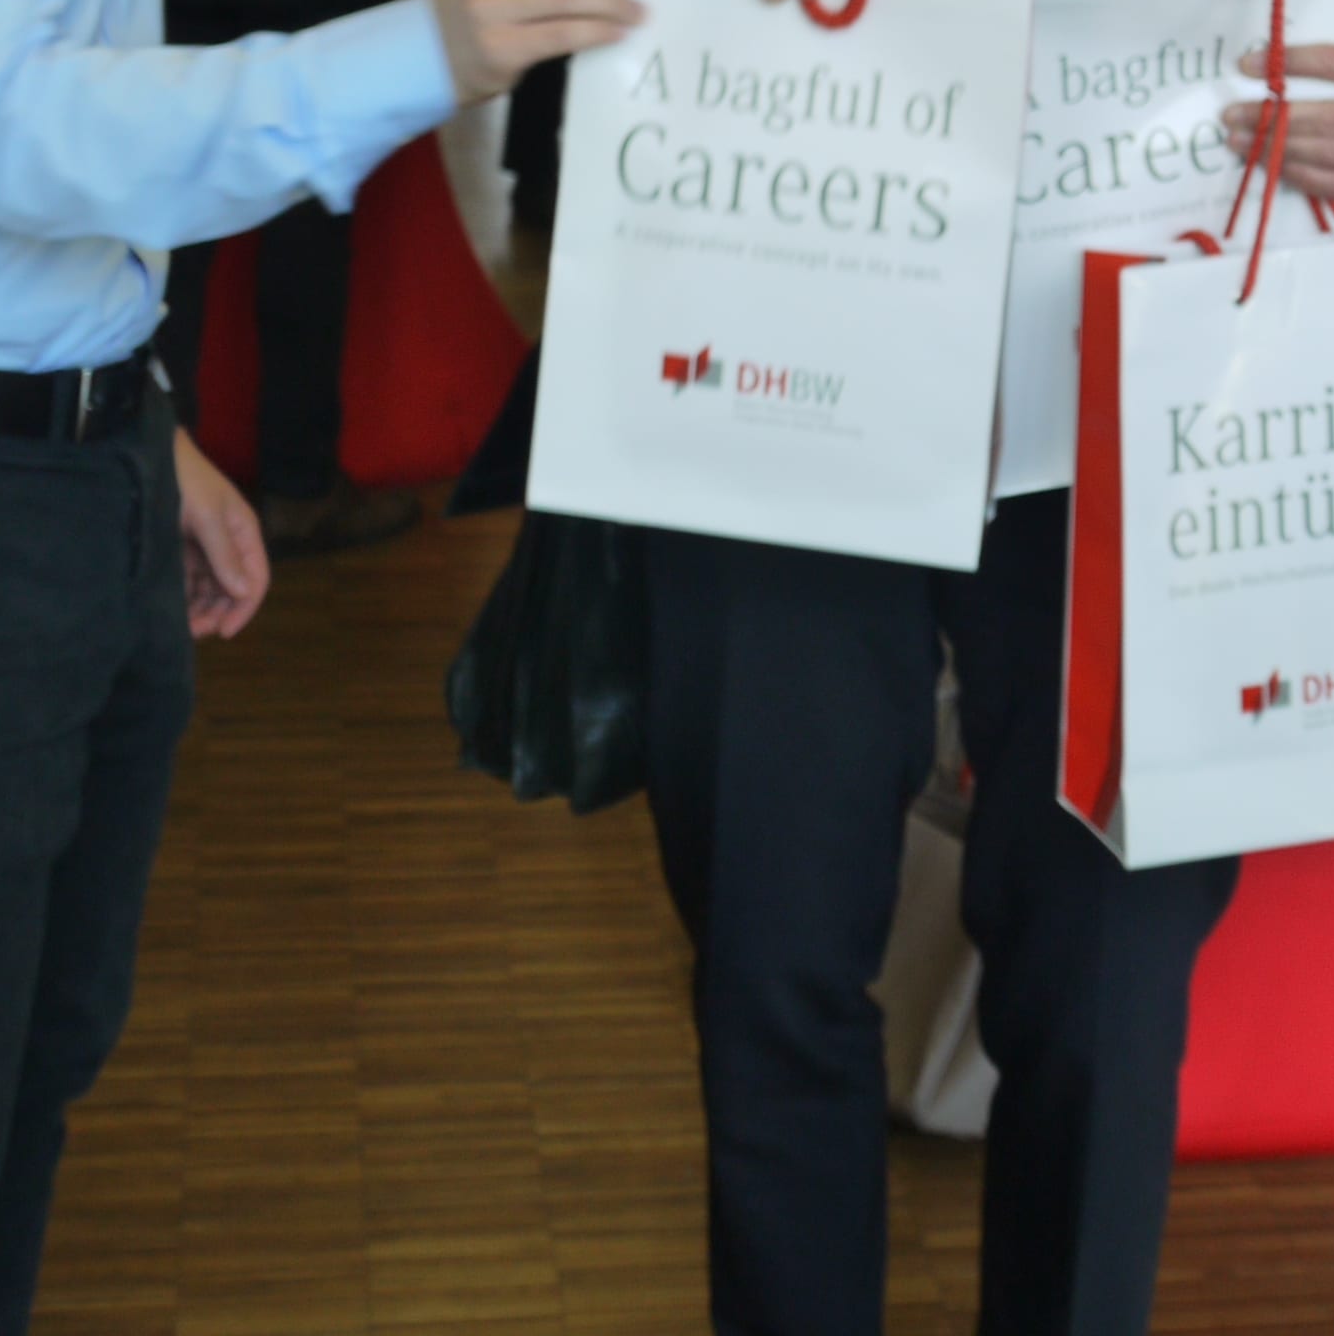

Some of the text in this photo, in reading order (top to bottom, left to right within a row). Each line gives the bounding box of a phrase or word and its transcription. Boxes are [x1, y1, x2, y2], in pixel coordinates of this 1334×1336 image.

[629, 46, 966, 140] A bagful of
[1059, 35, 1225, 107] bagful
[615, 120, 953, 243] Careers
[1017, 118, 1232, 205] Caree
[736, 361, 845, 406] DHBW
